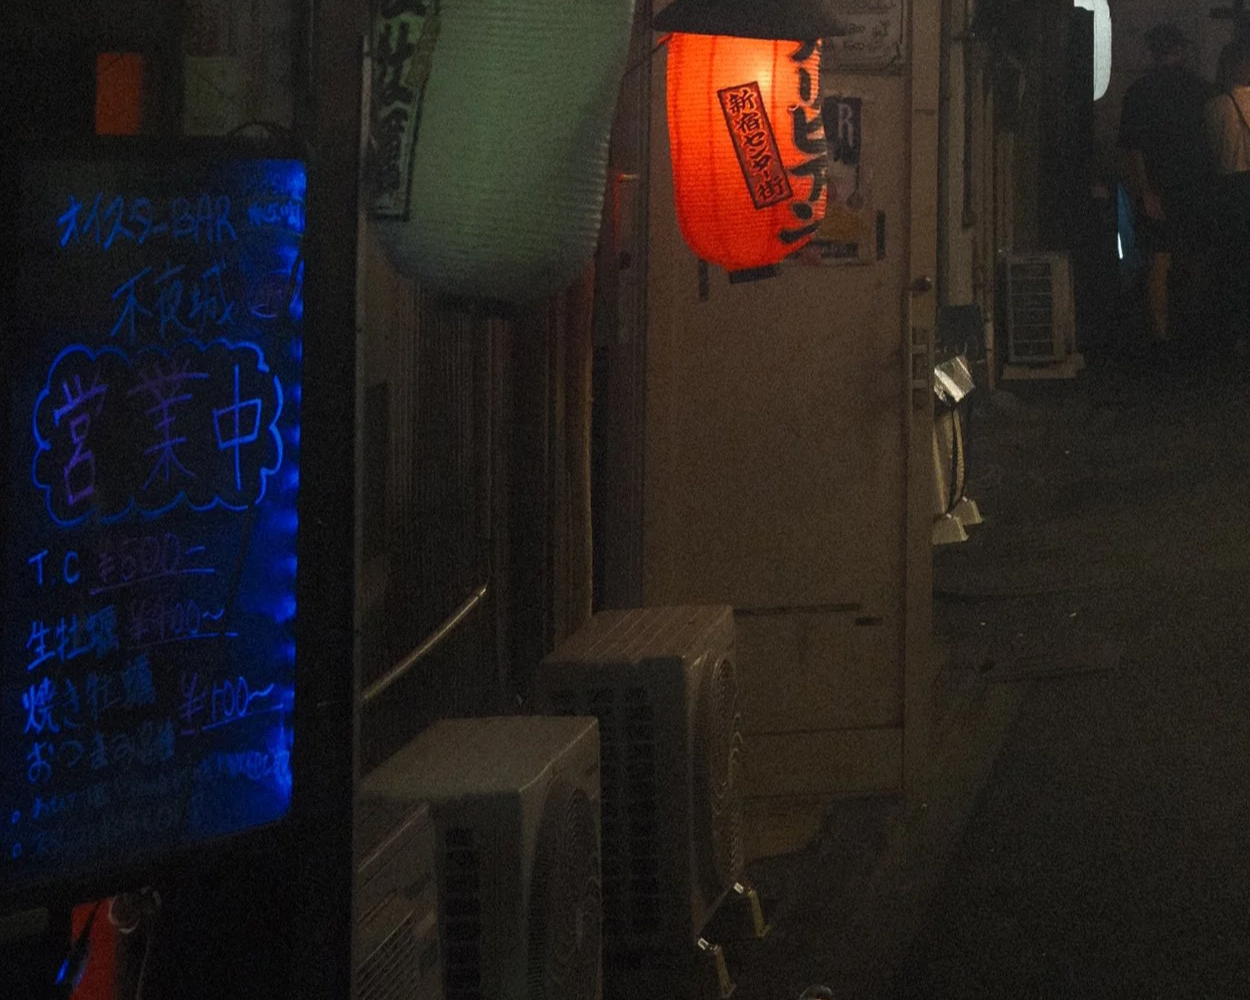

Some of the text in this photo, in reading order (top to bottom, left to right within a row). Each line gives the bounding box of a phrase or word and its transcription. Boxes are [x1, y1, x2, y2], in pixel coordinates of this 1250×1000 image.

[728, 88, 785, 202] 新宿センター街
[109, 258, 238, 338] 不夜城
[52, 358, 265, 508] 営業中
